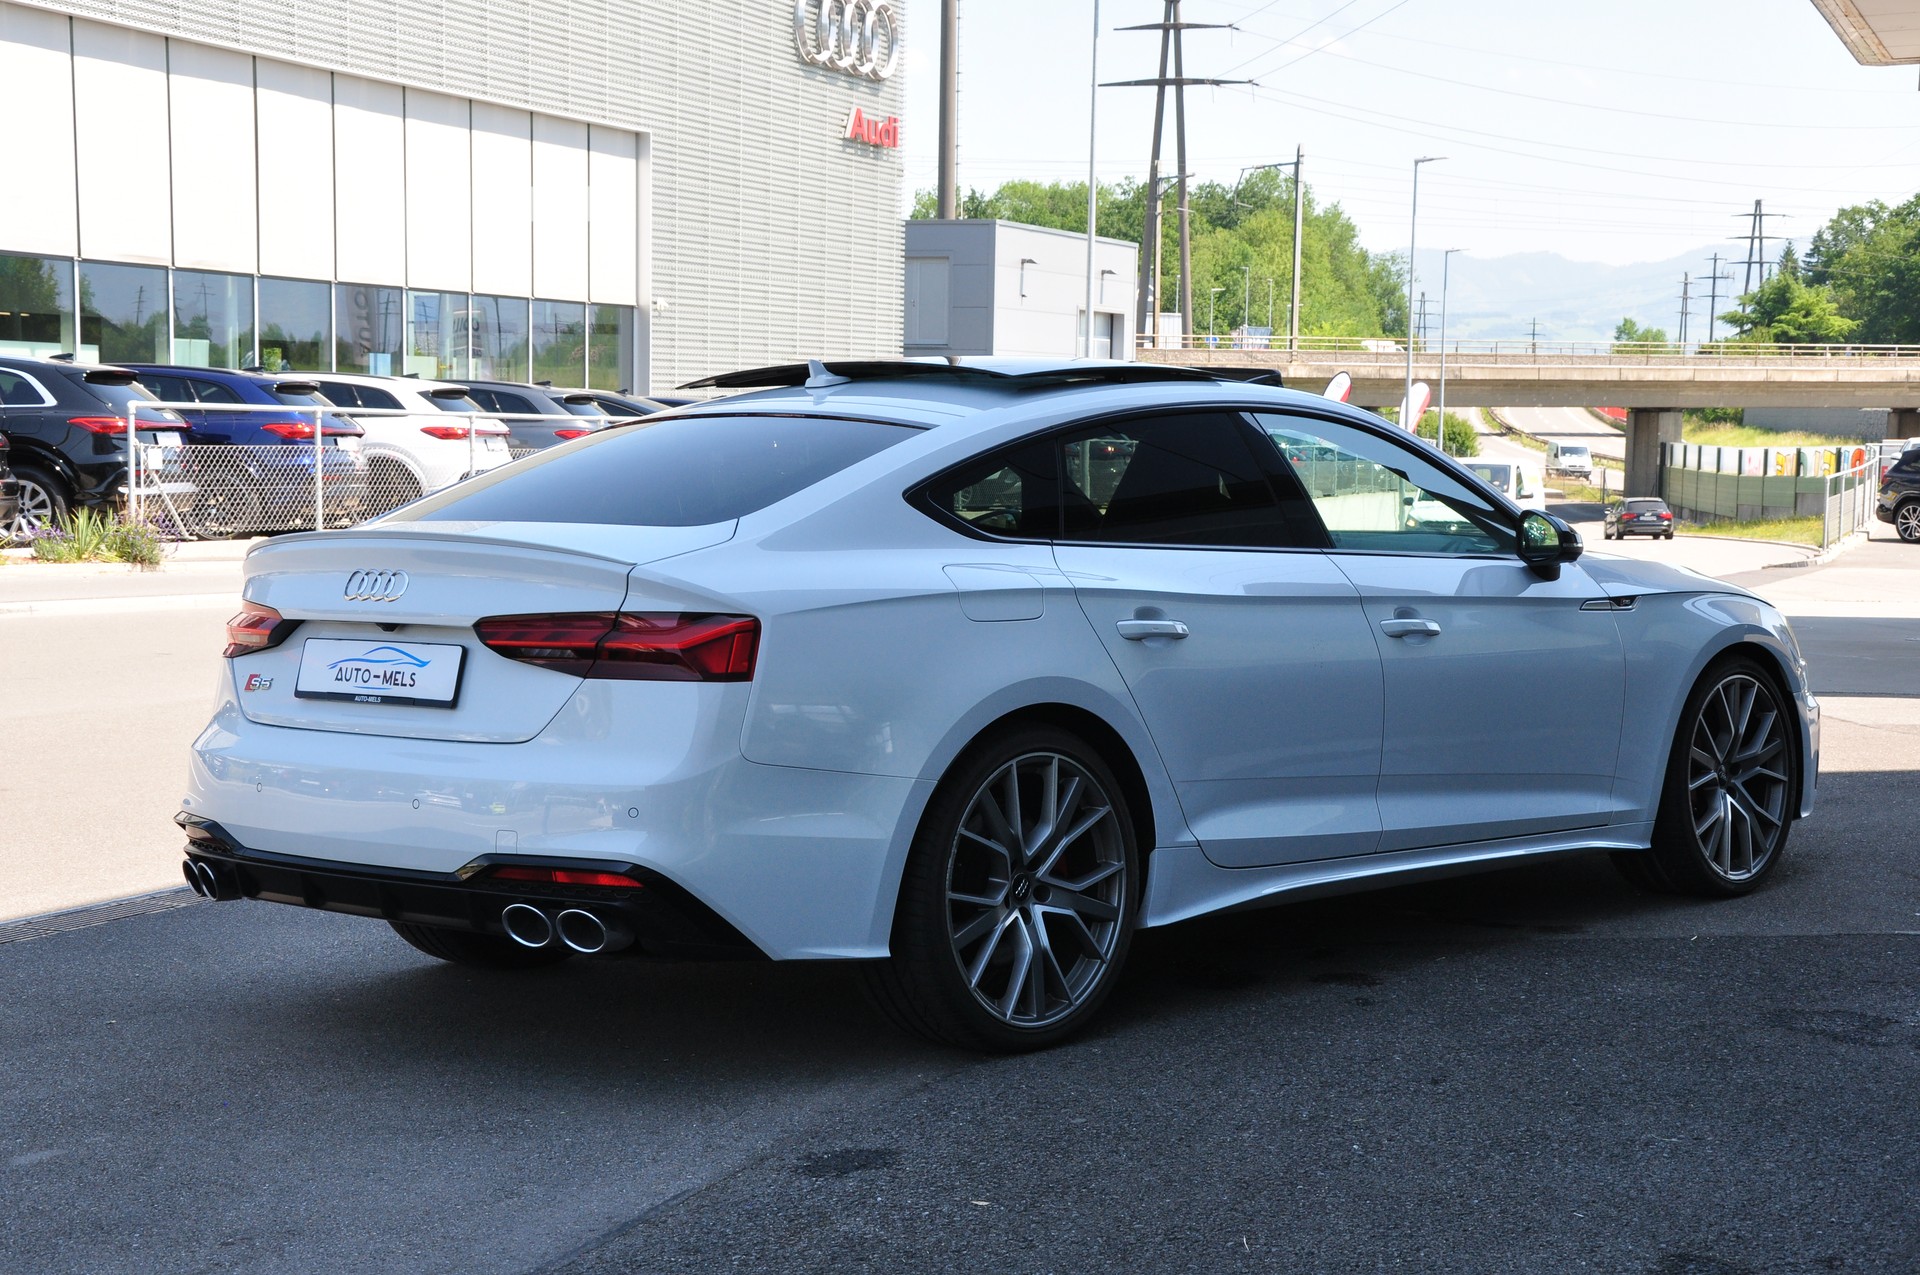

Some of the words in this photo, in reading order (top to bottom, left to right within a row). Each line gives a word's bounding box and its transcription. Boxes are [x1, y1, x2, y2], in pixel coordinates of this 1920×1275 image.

[848, 107, 899, 149] Audi
[249, 676, 274, 691] S5
[334, 667, 417, 688] AUTO-MELS
[354, 695, 382, 703] AUTO-MELS
